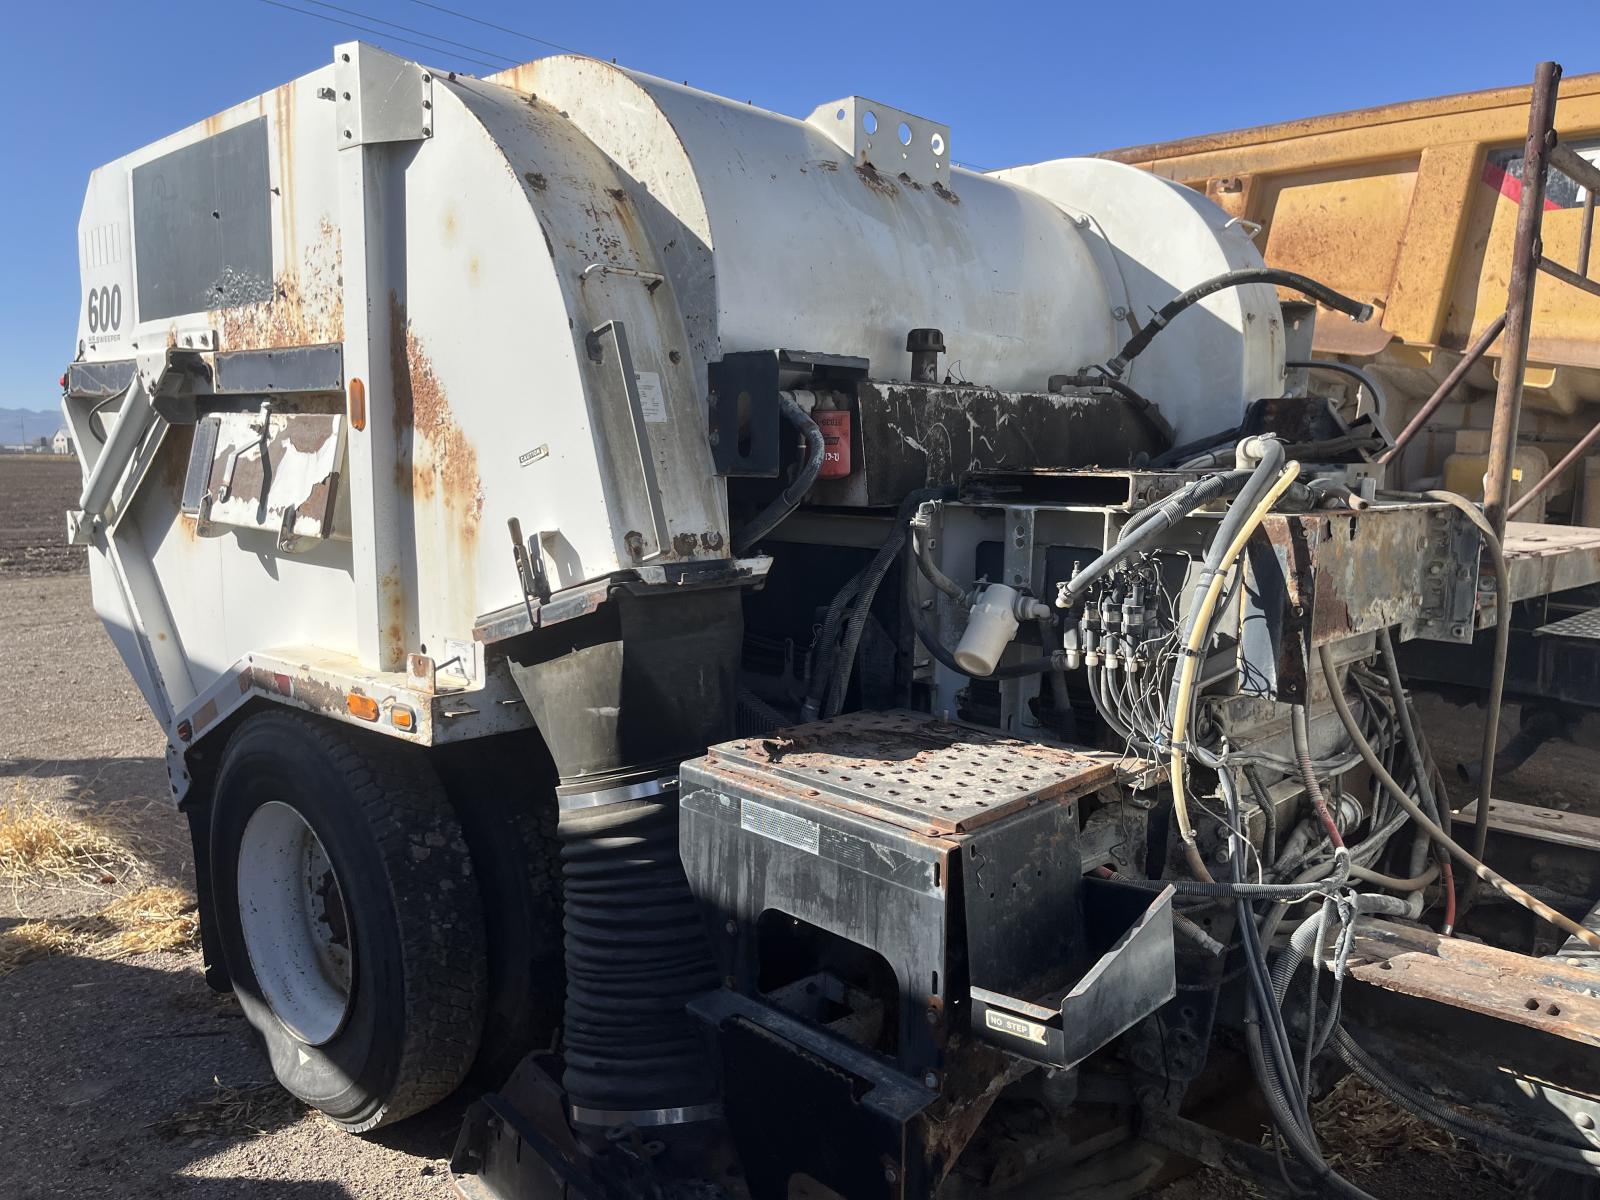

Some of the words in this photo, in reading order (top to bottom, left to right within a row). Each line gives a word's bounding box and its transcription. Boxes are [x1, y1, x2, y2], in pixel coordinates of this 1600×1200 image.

[88, 283, 122, 334] 600
[990, 1015, 1003, 1026] NO
[1006, 1020, 1028, 1034] STEP
